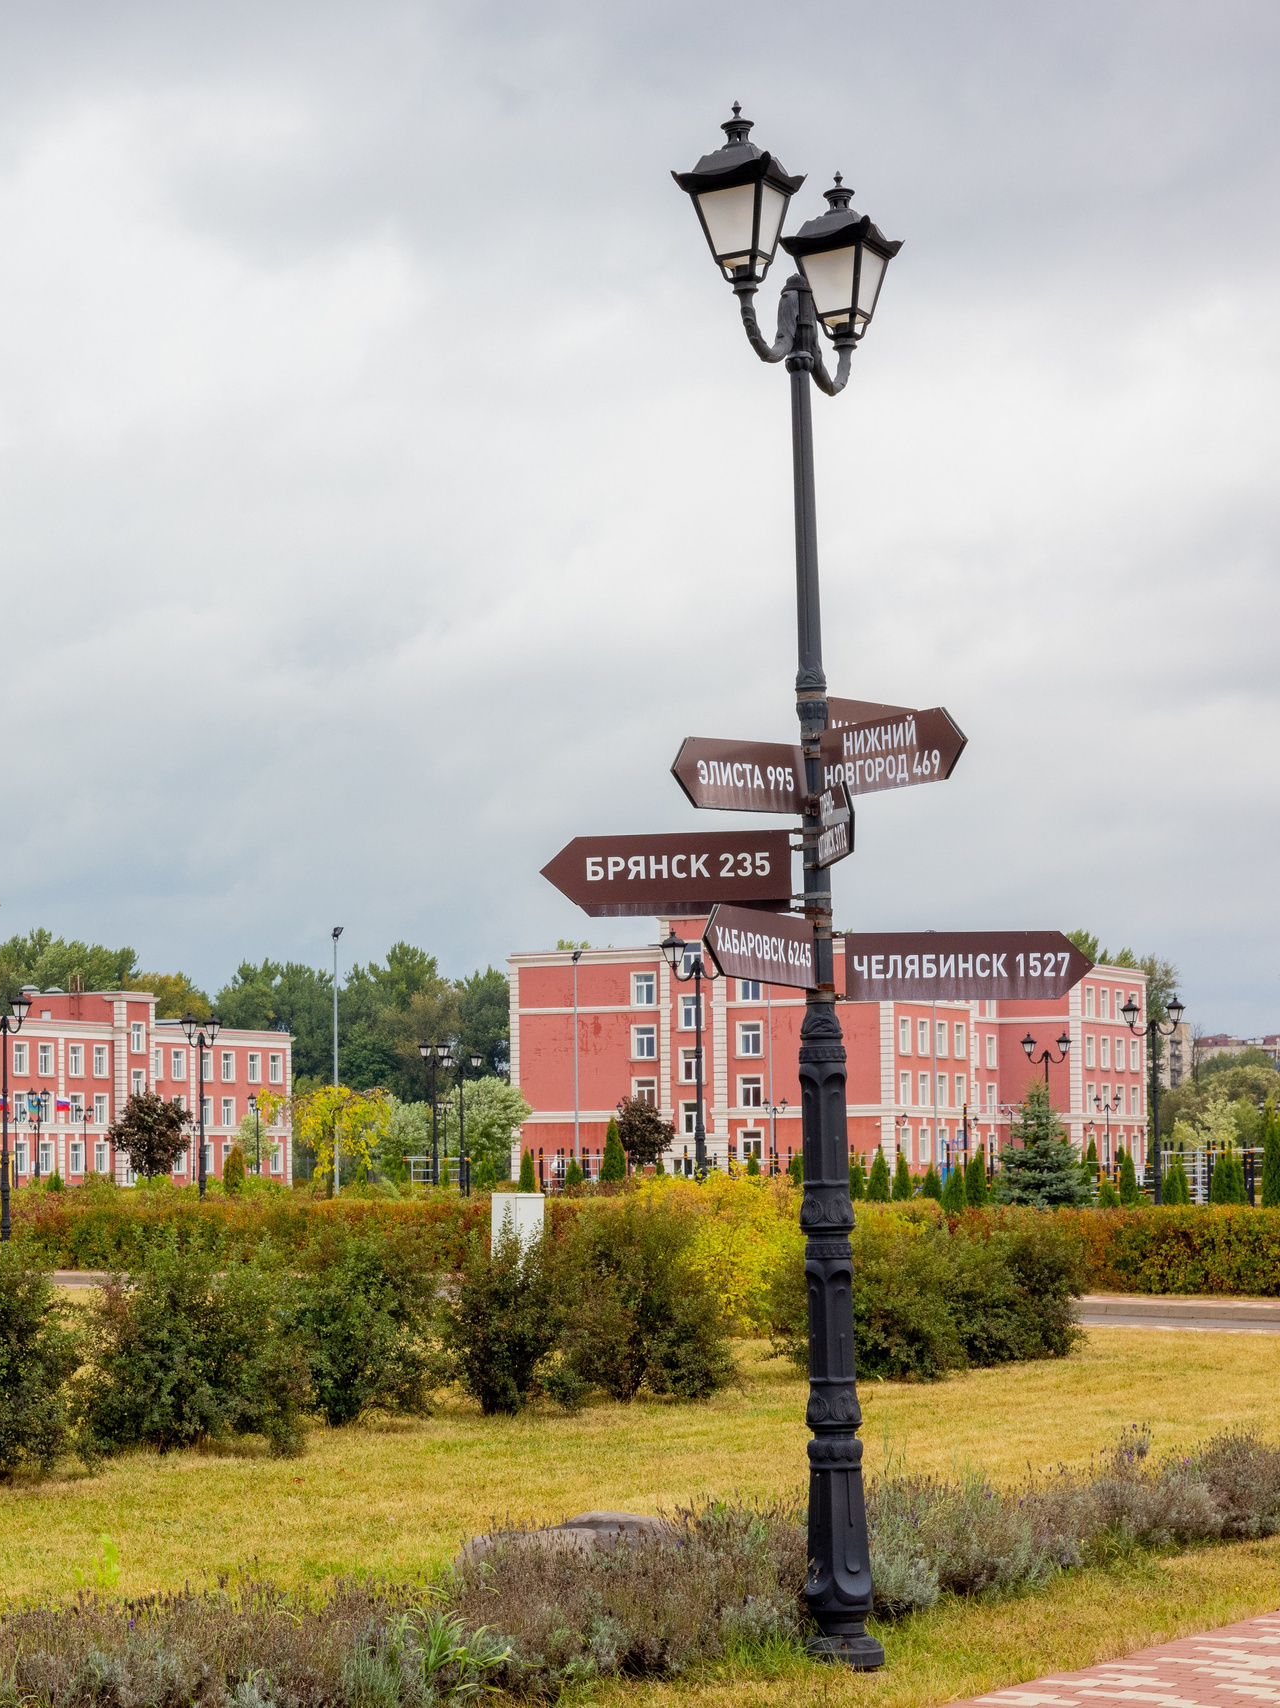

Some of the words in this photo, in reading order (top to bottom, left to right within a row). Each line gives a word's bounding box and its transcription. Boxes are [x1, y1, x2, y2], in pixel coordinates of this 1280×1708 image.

[843, 715, 917, 757] НИЖНИЙ
[696, 759, 765, 789] ЭЛИСТА
[766, 765, 795, 792] 995
[824, 751, 909, 789] НОВГОРОД
[912, 749, 941, 777] 469
[586, 853, 711, 881] БРЯНСК
[719, 851, 771, 878] 235
[715, 925, 787, 964] ХАБАРОВСК
[787, 942, 812, 969] 6245
[853, 953, 1008, 980] ЧЕЛЯБИНСК
[1015, 952, 1070, 977] 1527
